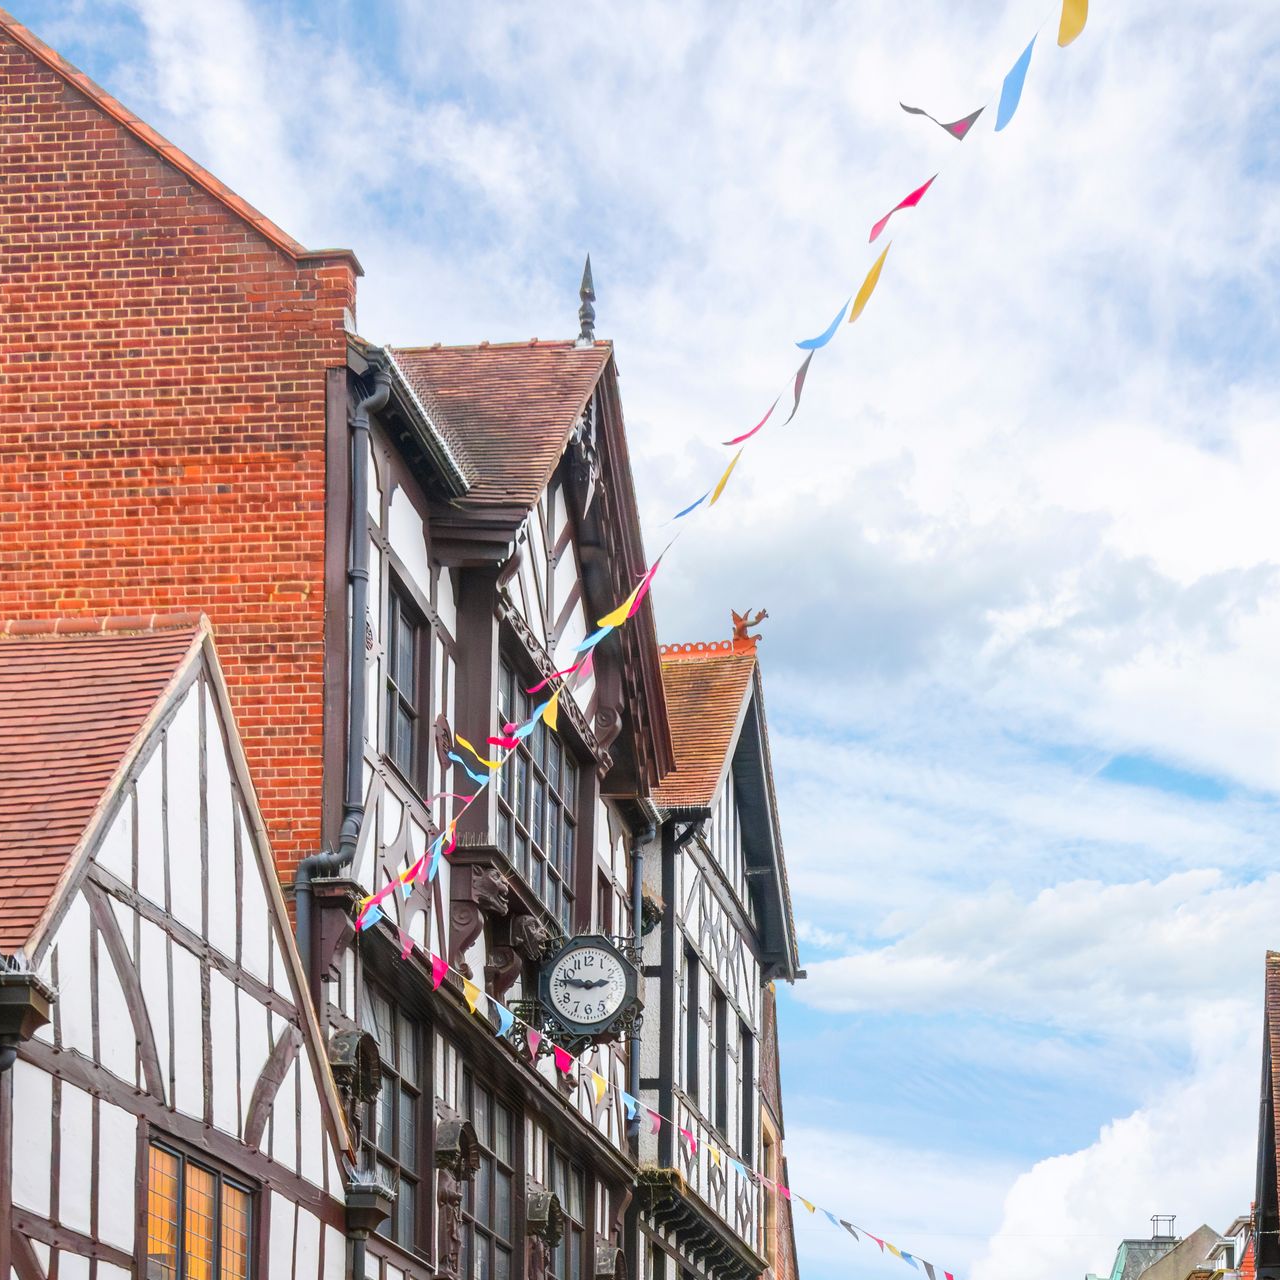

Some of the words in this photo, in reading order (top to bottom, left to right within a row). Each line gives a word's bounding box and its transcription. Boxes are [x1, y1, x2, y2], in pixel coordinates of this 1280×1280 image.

[584, 955, 594, 967] 12
[563, 968, 575, 980] 10
[607, 968, 615, 979] 2
[563, 992, 571, 1004] 8
[573, 1001, 580, 1013] 7
[584, 1003, 592, 1015] 6
[597, 1000, 606, 1012] 5
